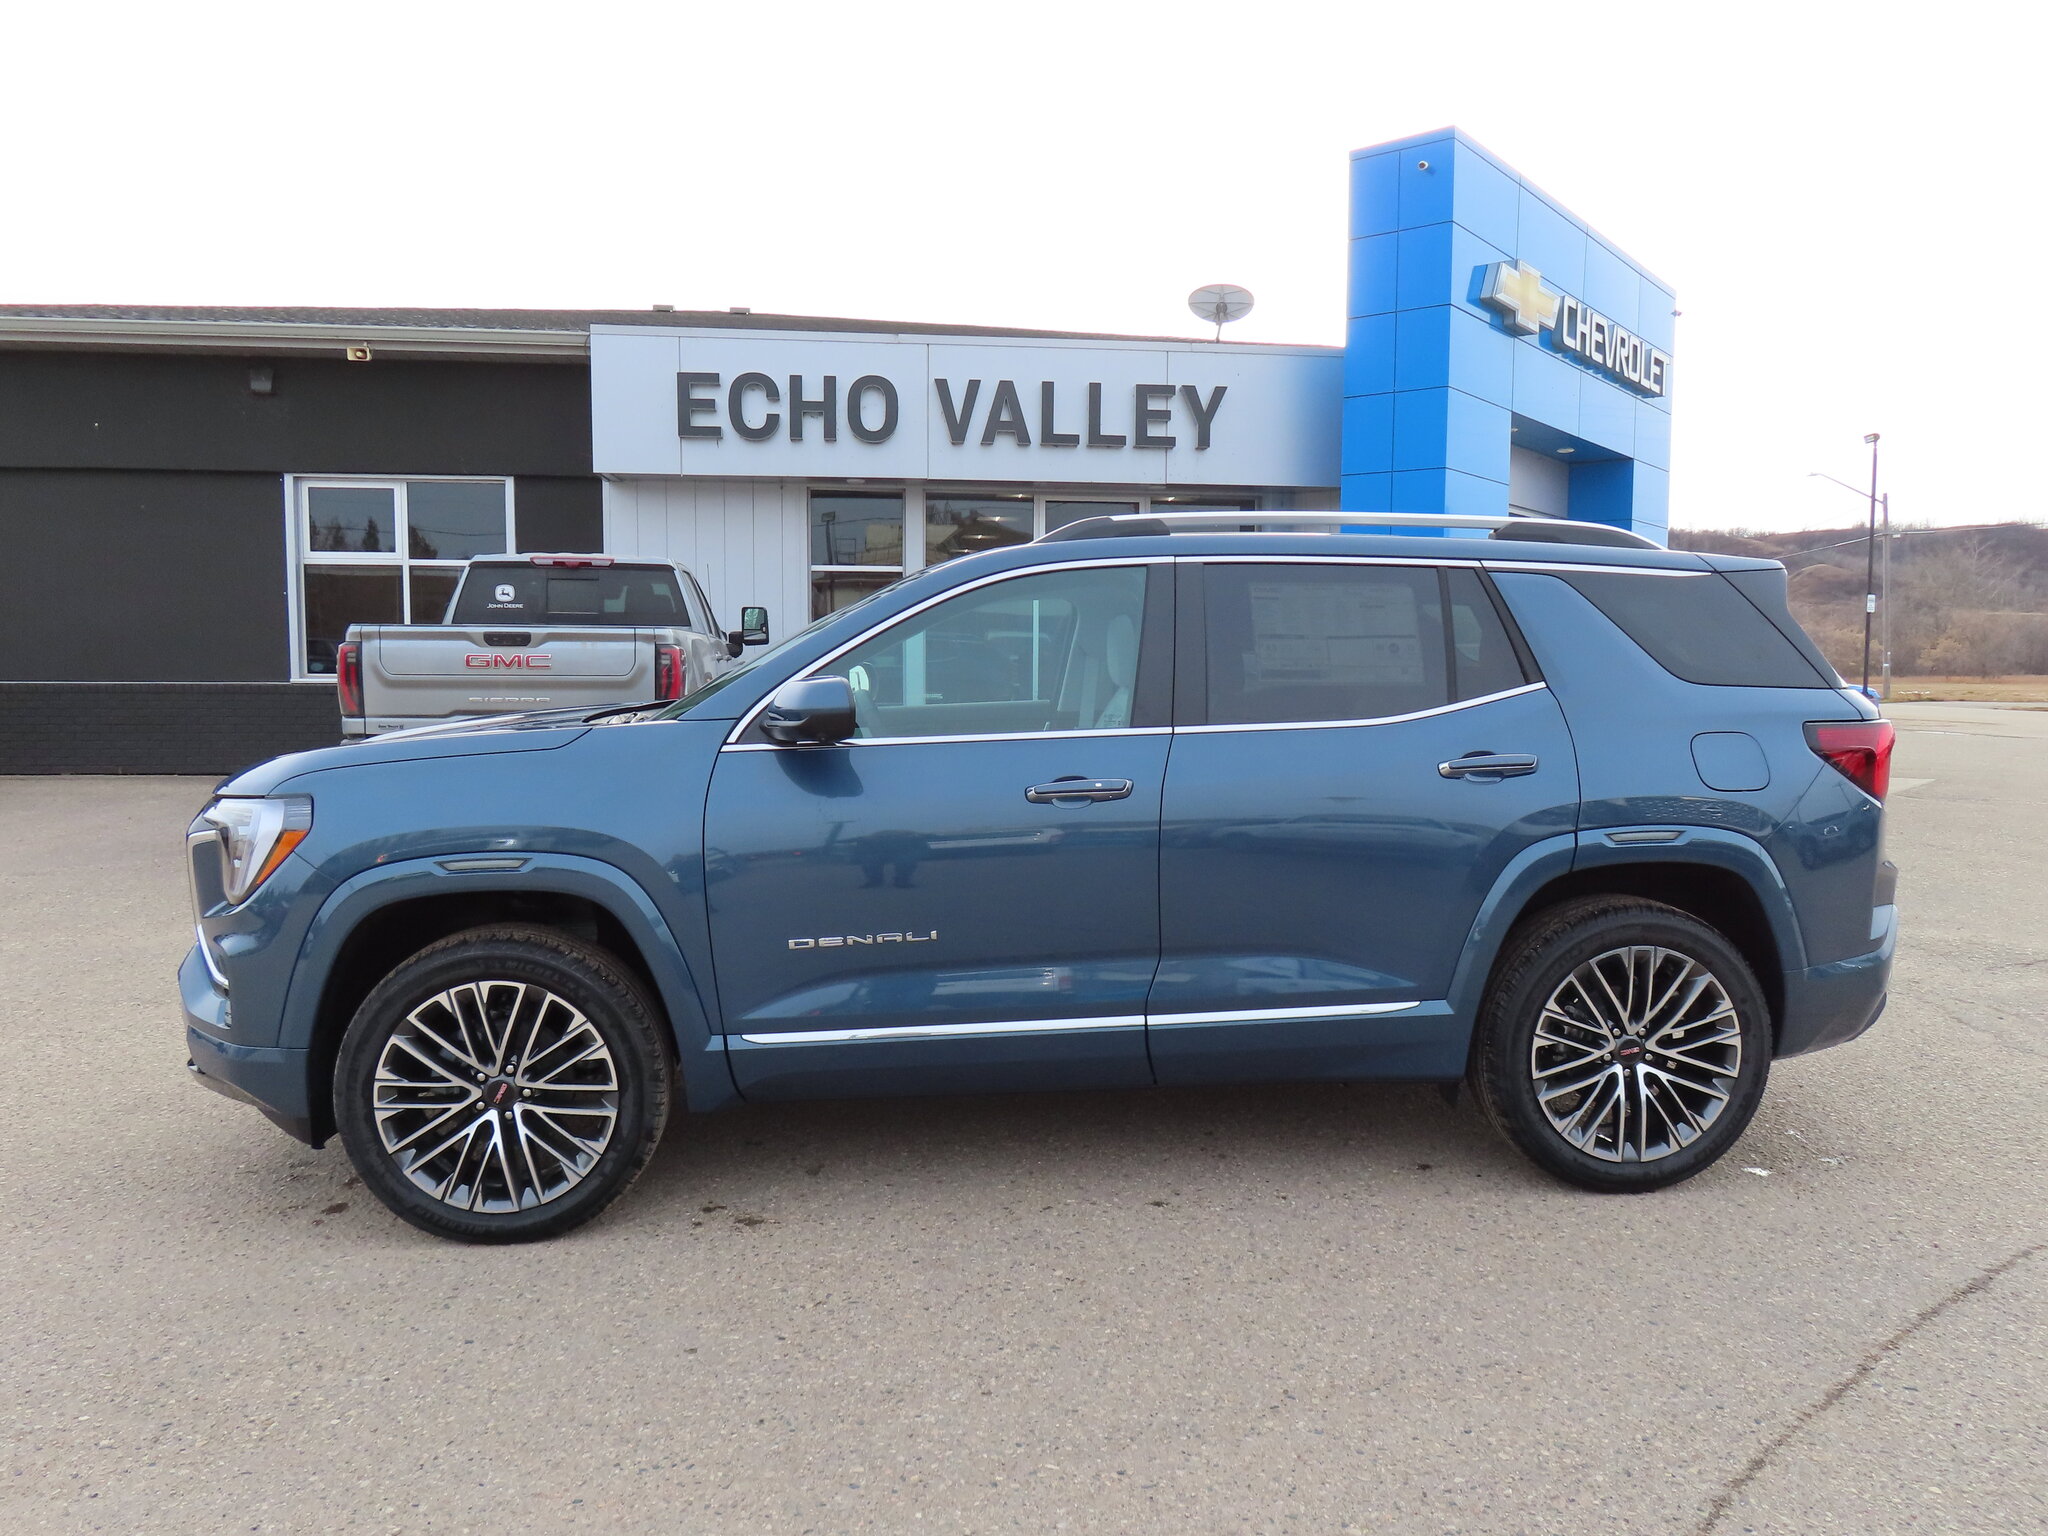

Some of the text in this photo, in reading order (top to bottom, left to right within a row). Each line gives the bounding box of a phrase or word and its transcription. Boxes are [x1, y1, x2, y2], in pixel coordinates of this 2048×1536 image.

[1559, 295, 1670, 397] CHEVROLET
[676, 372, 1228, 450] ECHO VALLEY
[465, 653, 552, 669] GMC
[788, 930, 938, 950] DENALI
